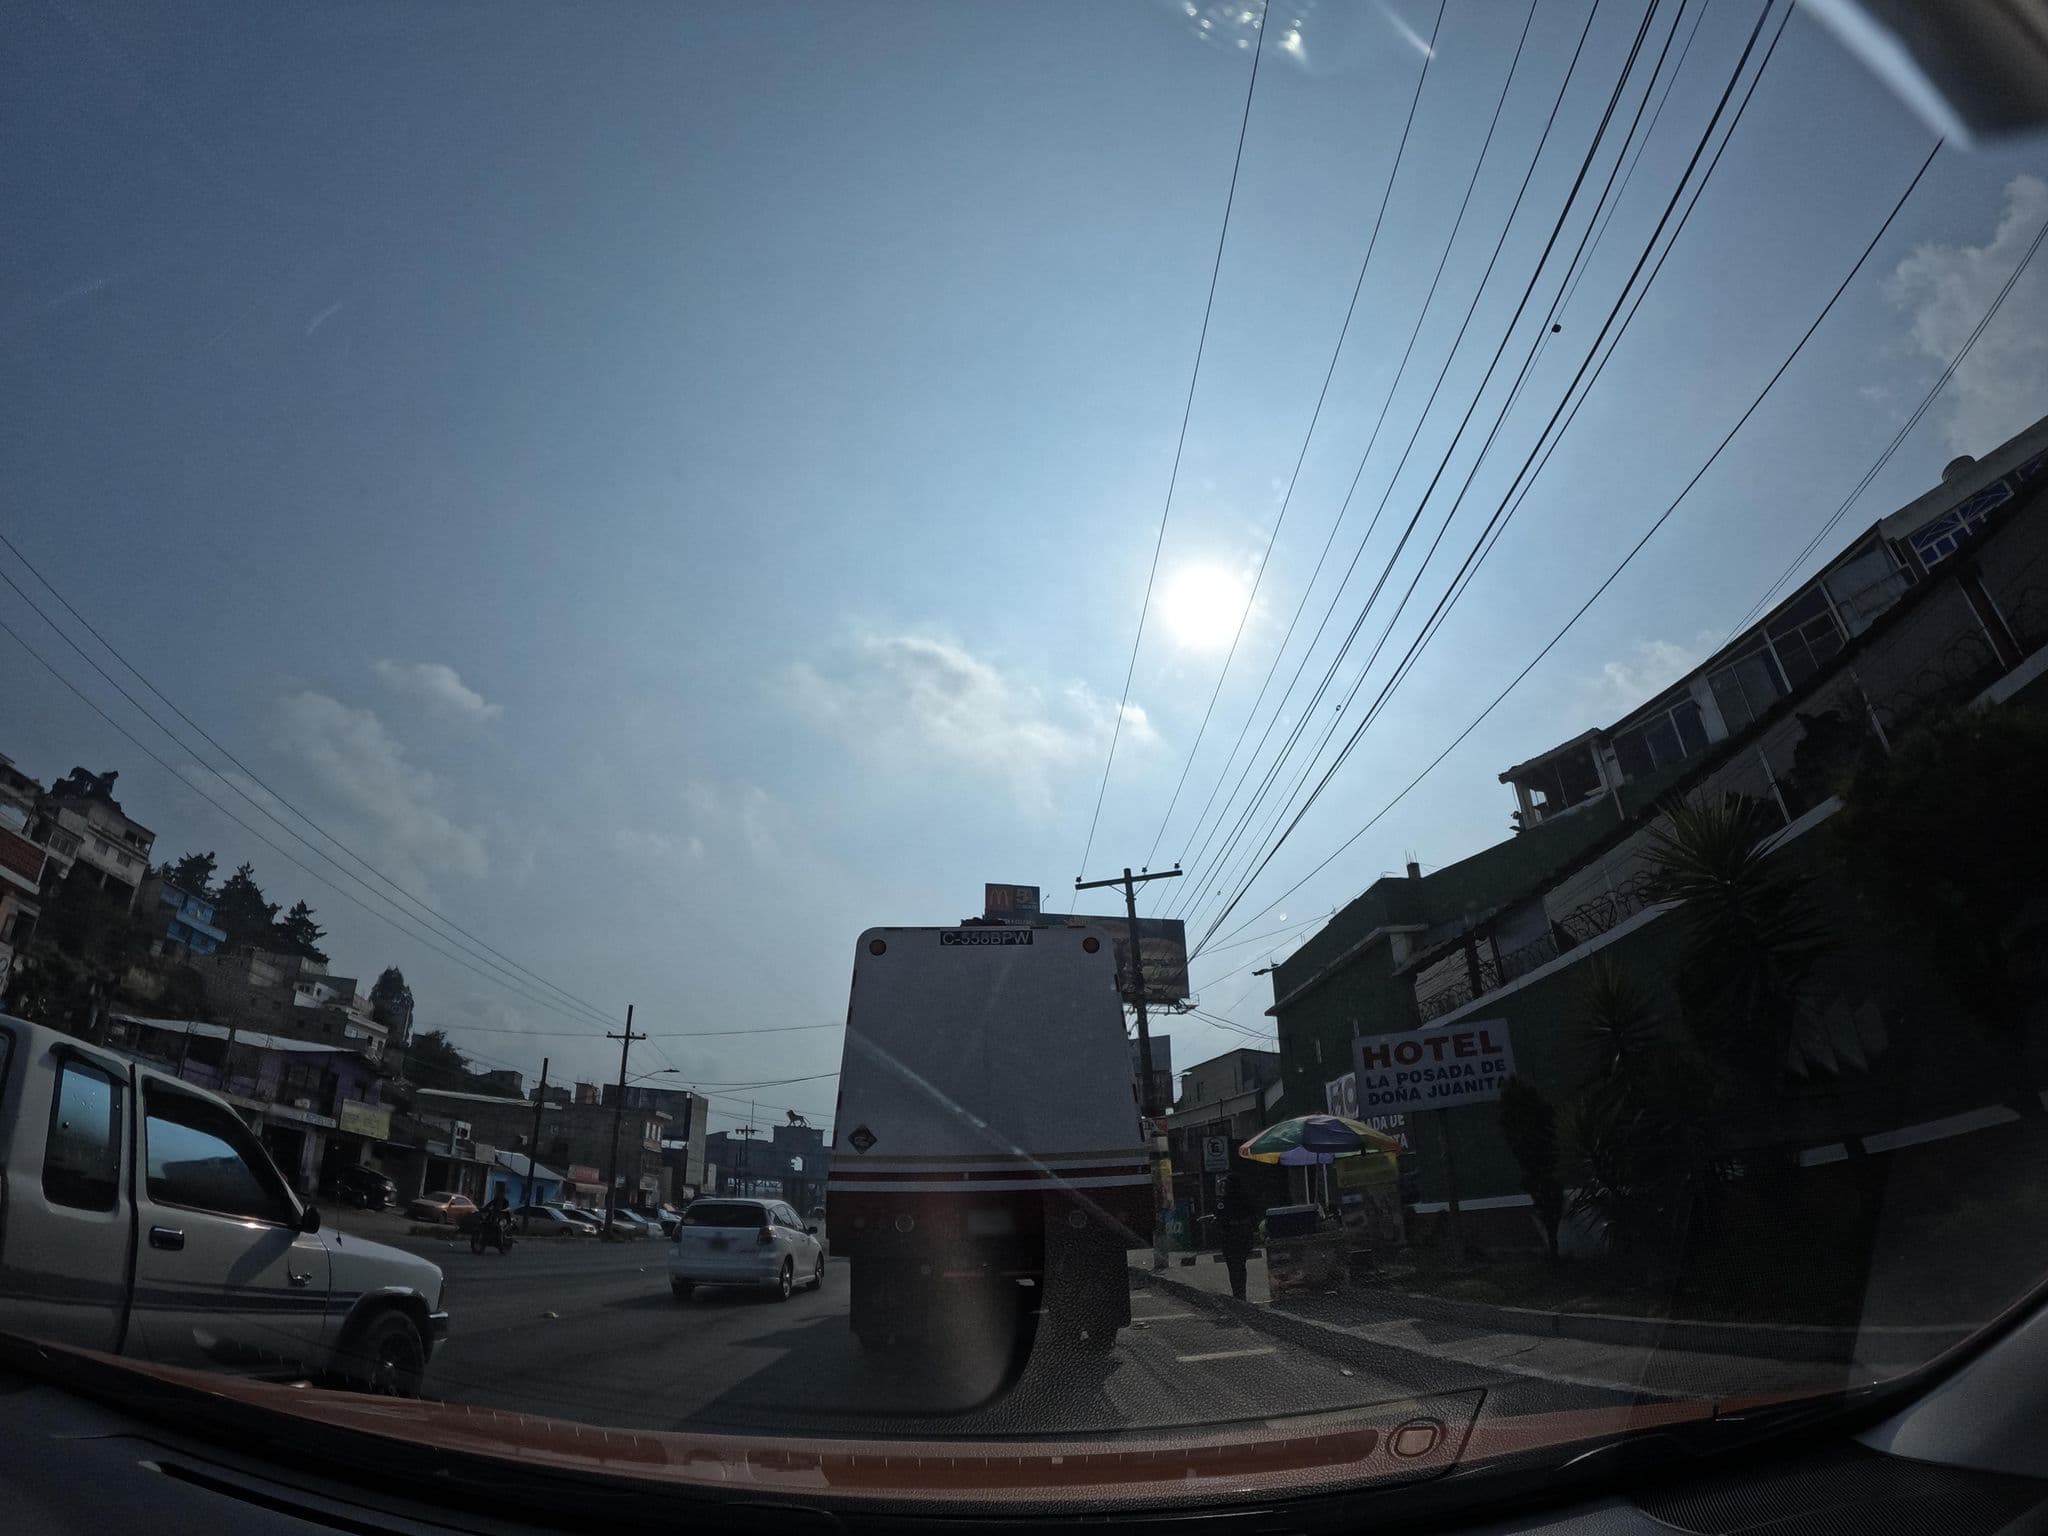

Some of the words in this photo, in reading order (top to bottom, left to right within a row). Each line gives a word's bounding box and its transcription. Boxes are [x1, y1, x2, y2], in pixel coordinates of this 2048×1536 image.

[1362, 1030, 1503, 1070] HOTEL
[1366, 1074, 1390, 1090] LA
[1396, 1063, 1475, 1086] POSADA
[1481, 1058, 1507, 1074] DE
[1368, 1086, 1422, 1106] DOÑA
